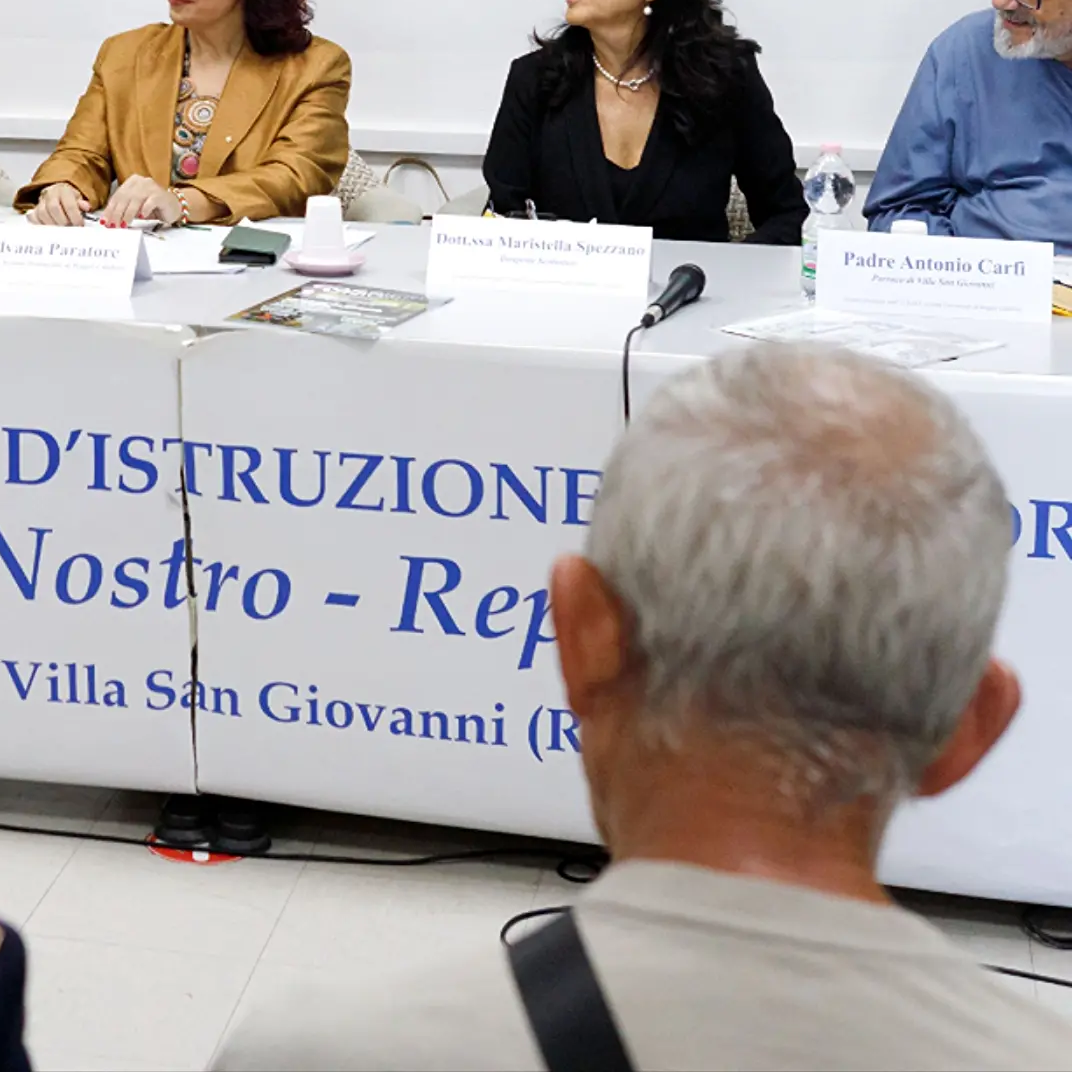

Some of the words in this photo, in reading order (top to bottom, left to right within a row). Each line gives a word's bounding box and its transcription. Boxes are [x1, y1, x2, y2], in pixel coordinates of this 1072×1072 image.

[49, 243, 121, 259] Paratore
[436, 233, 493, 247] Dott.ssa
[498, 236, 572, 253] Maristella
[577, 240, 646, 257] Spezzano
[844, 251, 896, 270] Padre
[900, 255, 972, 273] Antonio
[1, 426, 606, 527] D'ISTRUZIONE
[0, 659, 129, 708] Villa
[145, 669, 243, 717] San
[258, 681, 509, 747] Giovanni
